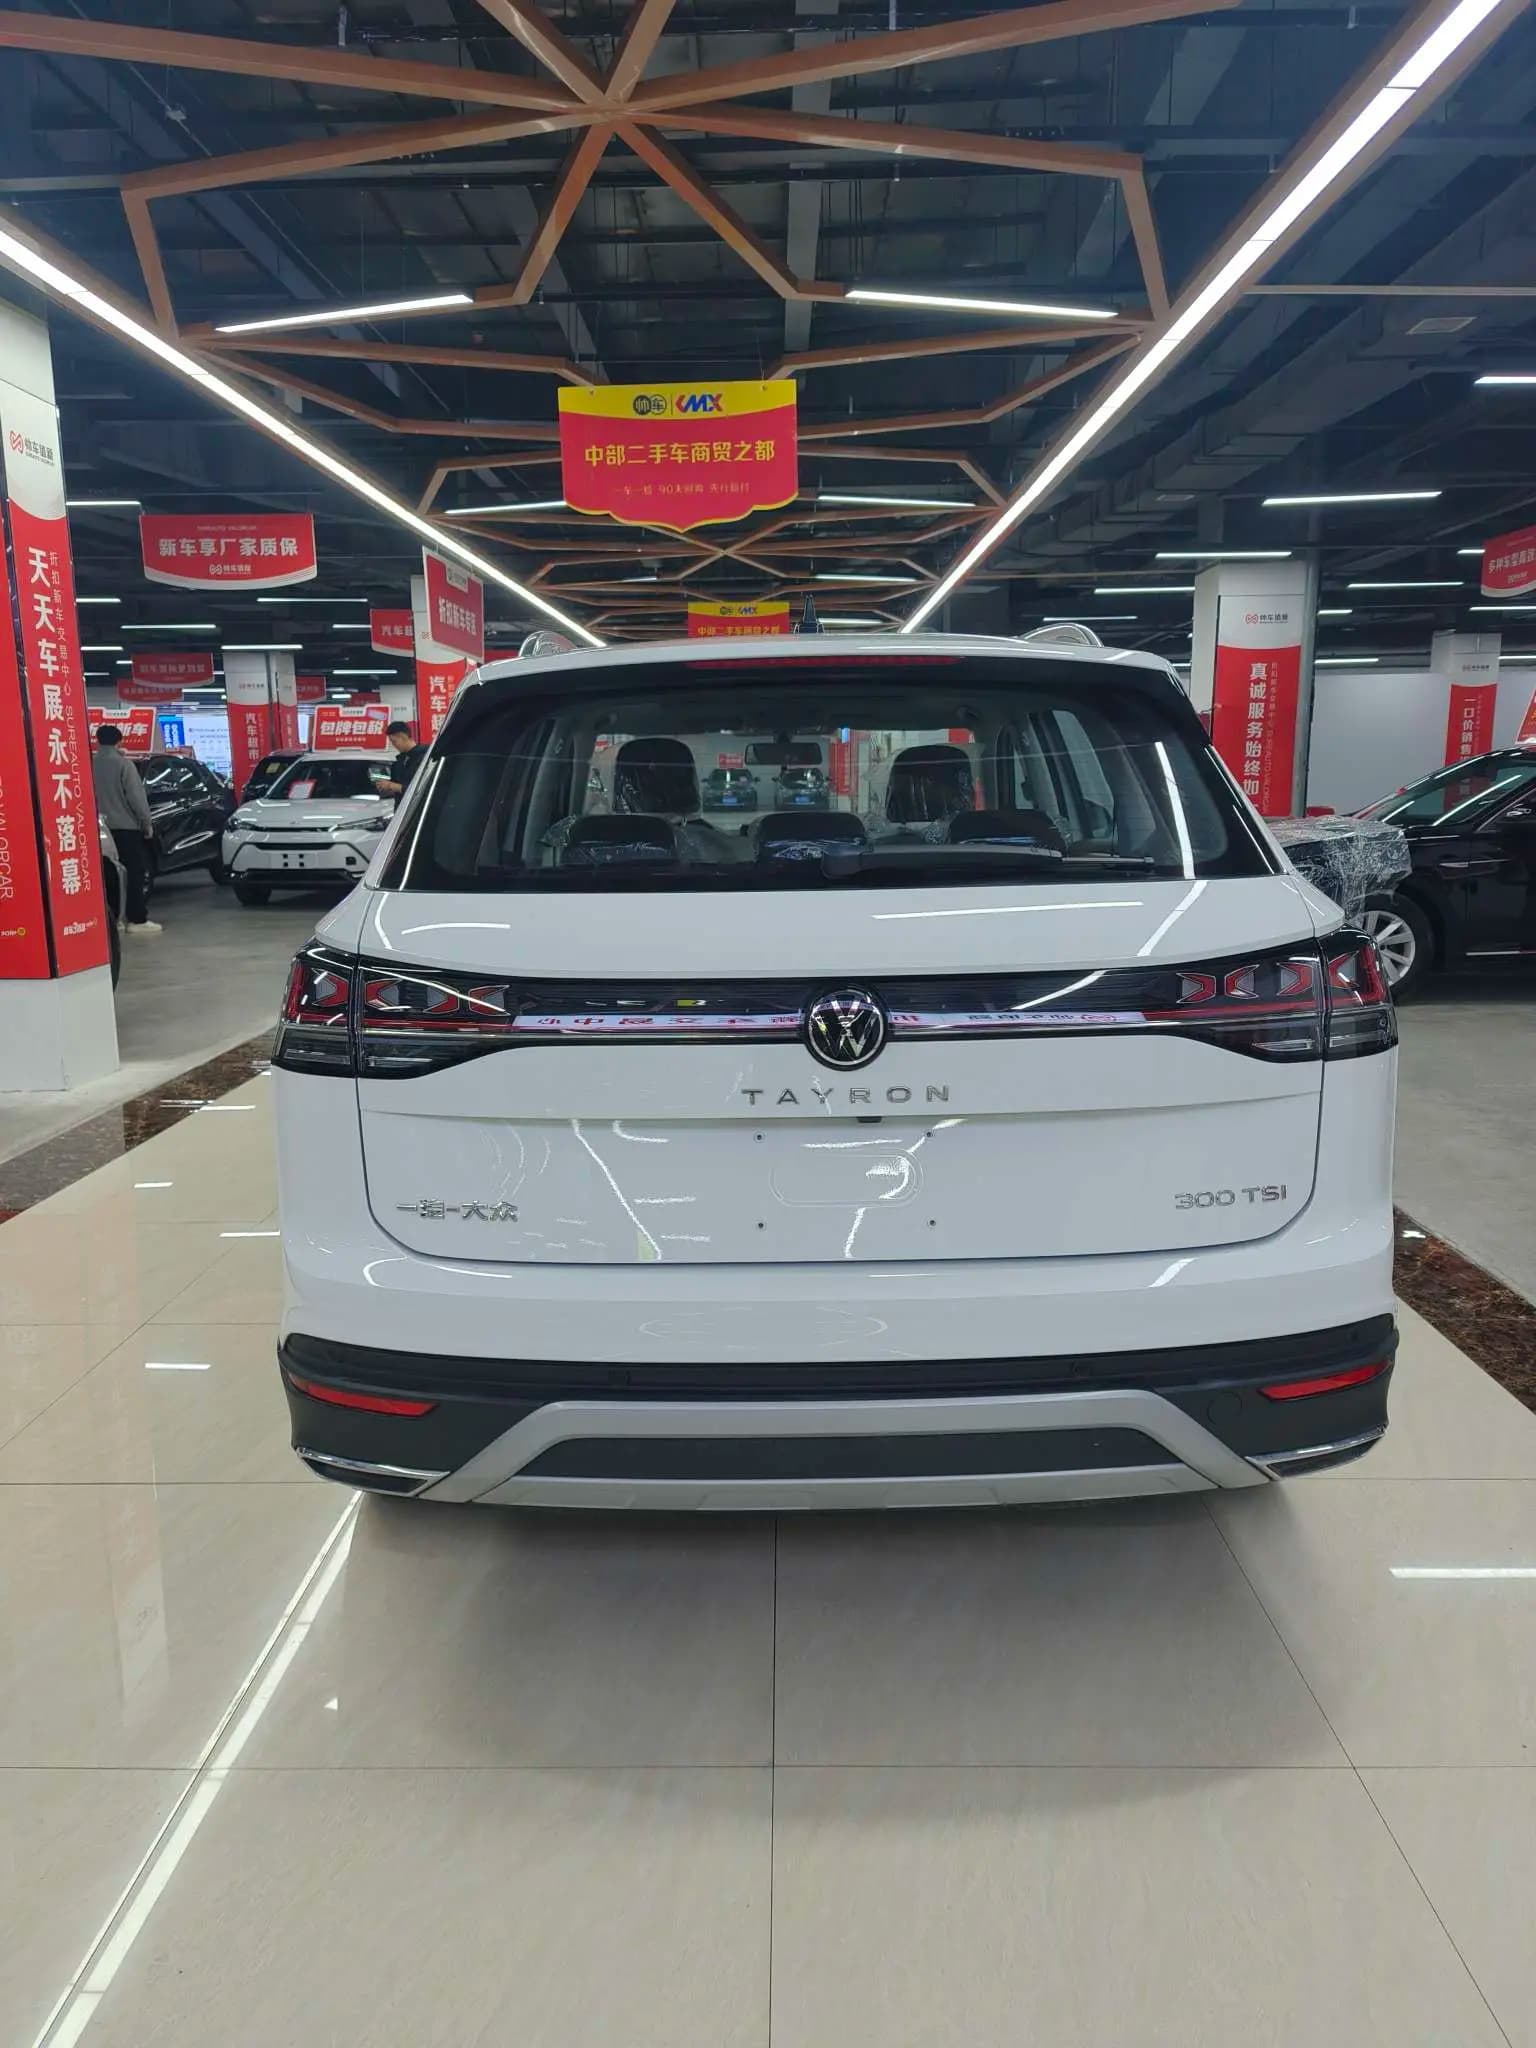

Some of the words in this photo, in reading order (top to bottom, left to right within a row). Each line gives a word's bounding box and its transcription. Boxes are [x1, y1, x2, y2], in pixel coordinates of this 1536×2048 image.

[584, 439, 776, 468] 中部二手车商贸之都
[158, 537, 299, 557] 新车享厂家质保
[49, 551, 73, 697] 折扣新车交易中心
[28, 546, 82, 895] 天天车展永不落幕
[319, 719, 384, 736] 包牌包税
[428, 676, 447, 737] 汽车超
[1242, 662, 1268, 808] 真诚服务始终如
[64, 705, 82, 800] SUREAUTO
[74, 801, 91, 892] VALORCAR
[741, 1084, 950, 1106] TAYRON
[1174, 1189, 1236, 1210] 300
[1241, 1184, 1287, 1203] TSI
